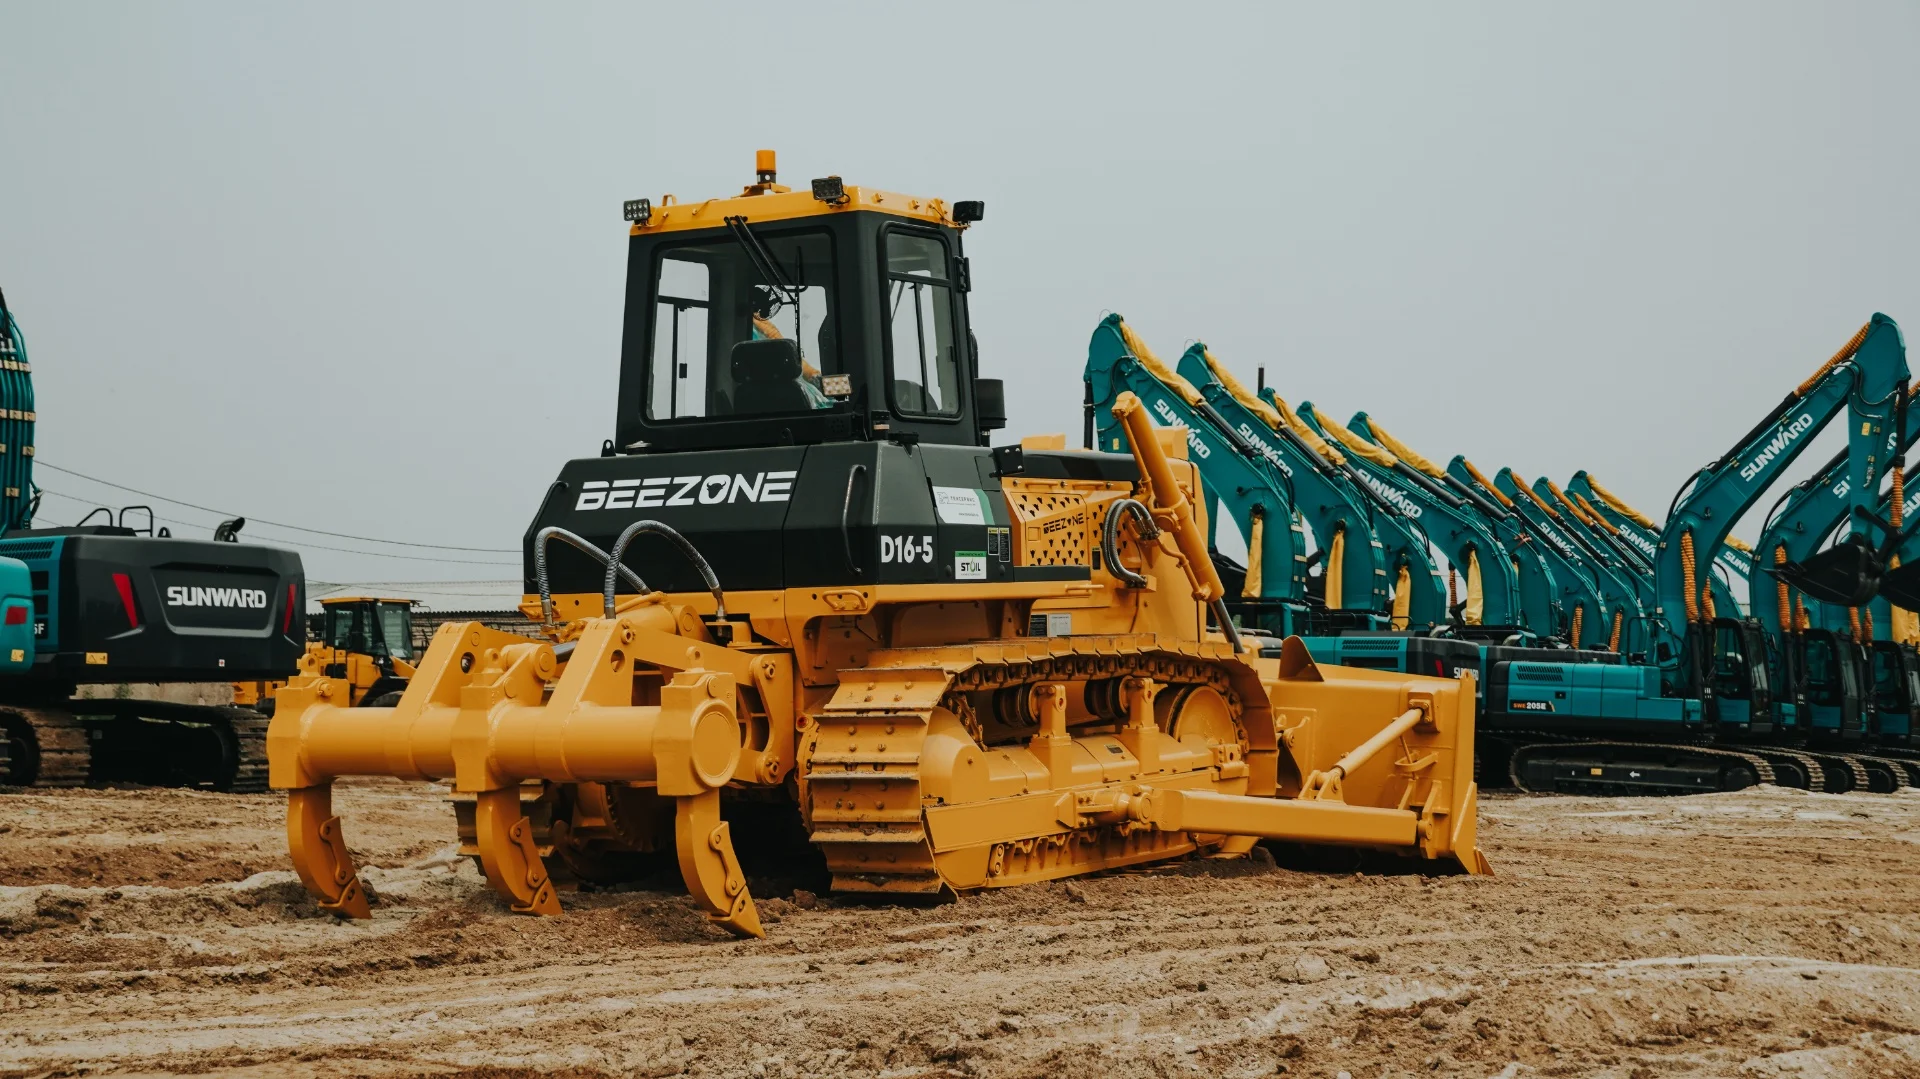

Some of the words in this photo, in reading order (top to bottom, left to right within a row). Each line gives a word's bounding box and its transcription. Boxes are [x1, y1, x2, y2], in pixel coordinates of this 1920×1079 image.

[1740, 413, 1813, 482] SUNWARD
[574, 470, 798, 511] BEEZONE
[880, 535, 933, 563] D16-5
[167, 586, 266, 608] SUNWARD
